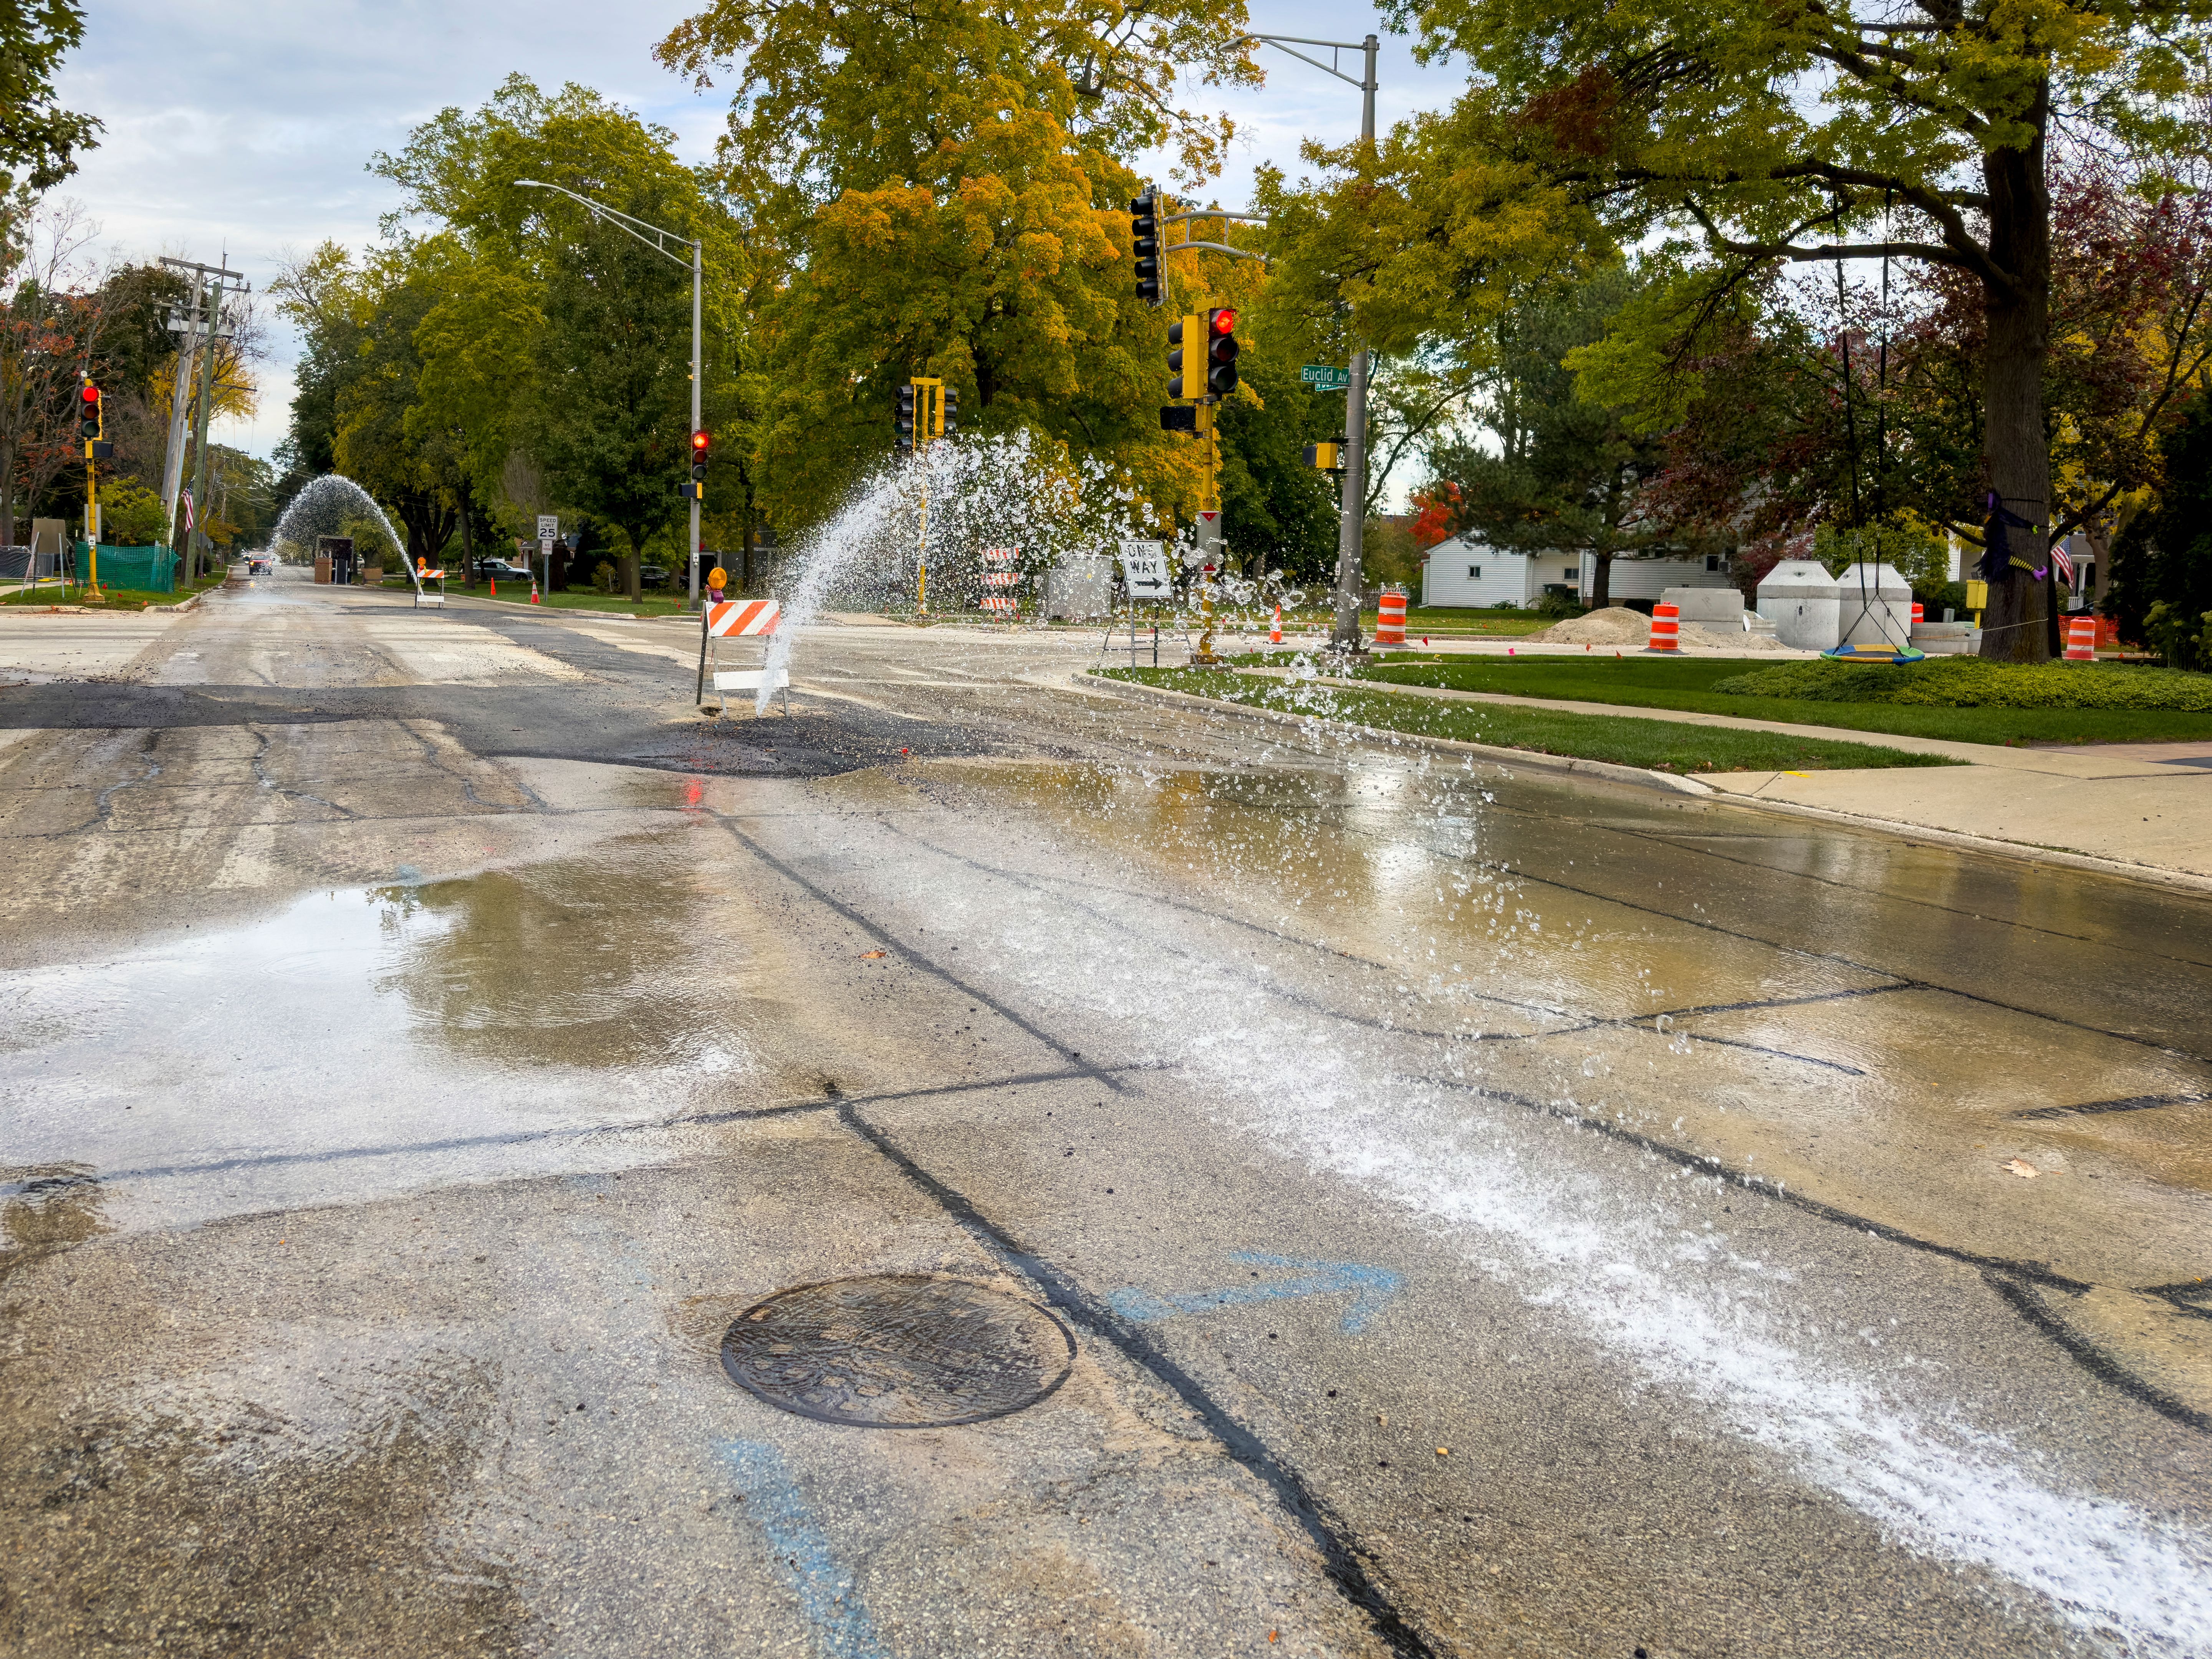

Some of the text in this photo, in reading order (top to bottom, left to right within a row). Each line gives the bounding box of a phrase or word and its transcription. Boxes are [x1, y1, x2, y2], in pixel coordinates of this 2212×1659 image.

[1303, 368, 1348, 382] Euclid Av
[540, 528, 555, 537] 25
[1130, 561, 1157, 573] WAY
